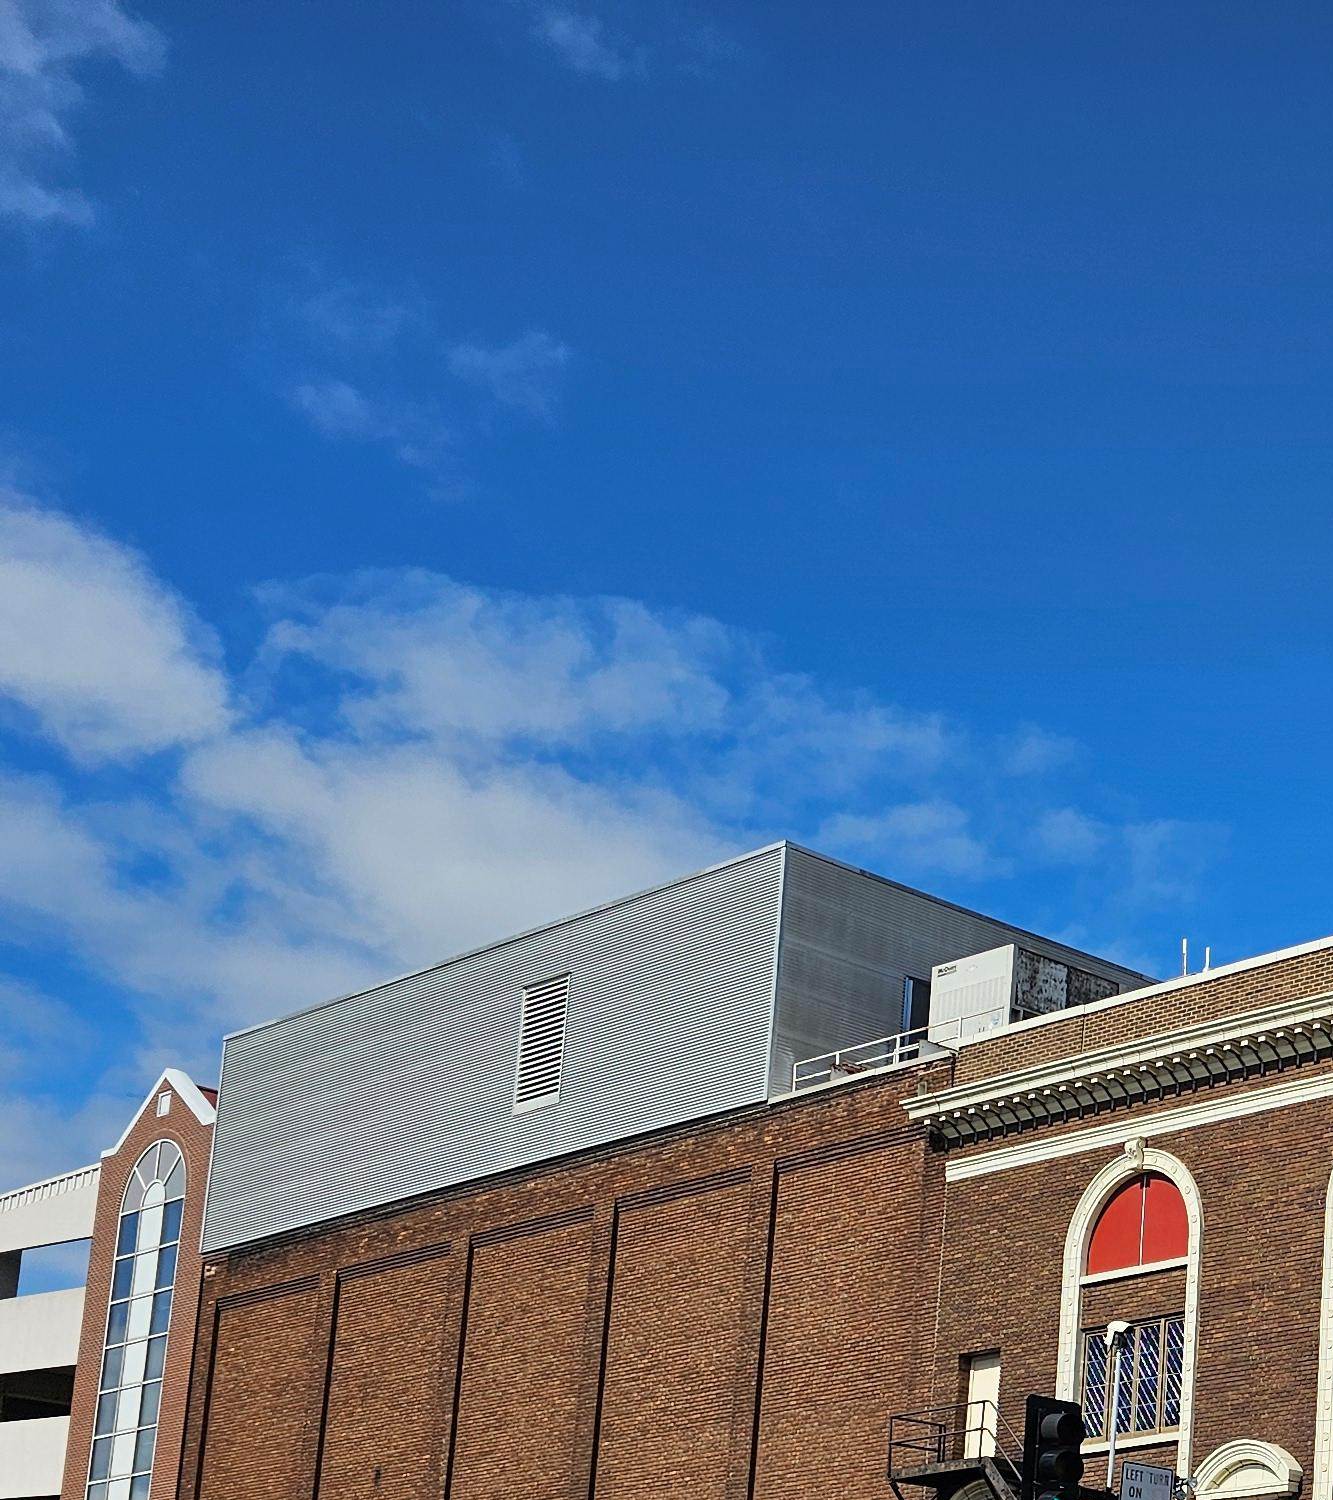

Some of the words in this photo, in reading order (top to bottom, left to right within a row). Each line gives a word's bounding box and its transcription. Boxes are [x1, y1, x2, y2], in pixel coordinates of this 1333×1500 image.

[1125, 1468, 1144, 1482] LEFT
[1149, 1472, 1170, 1486] TURN
[1128, 1486, 1143, 1499] ON
